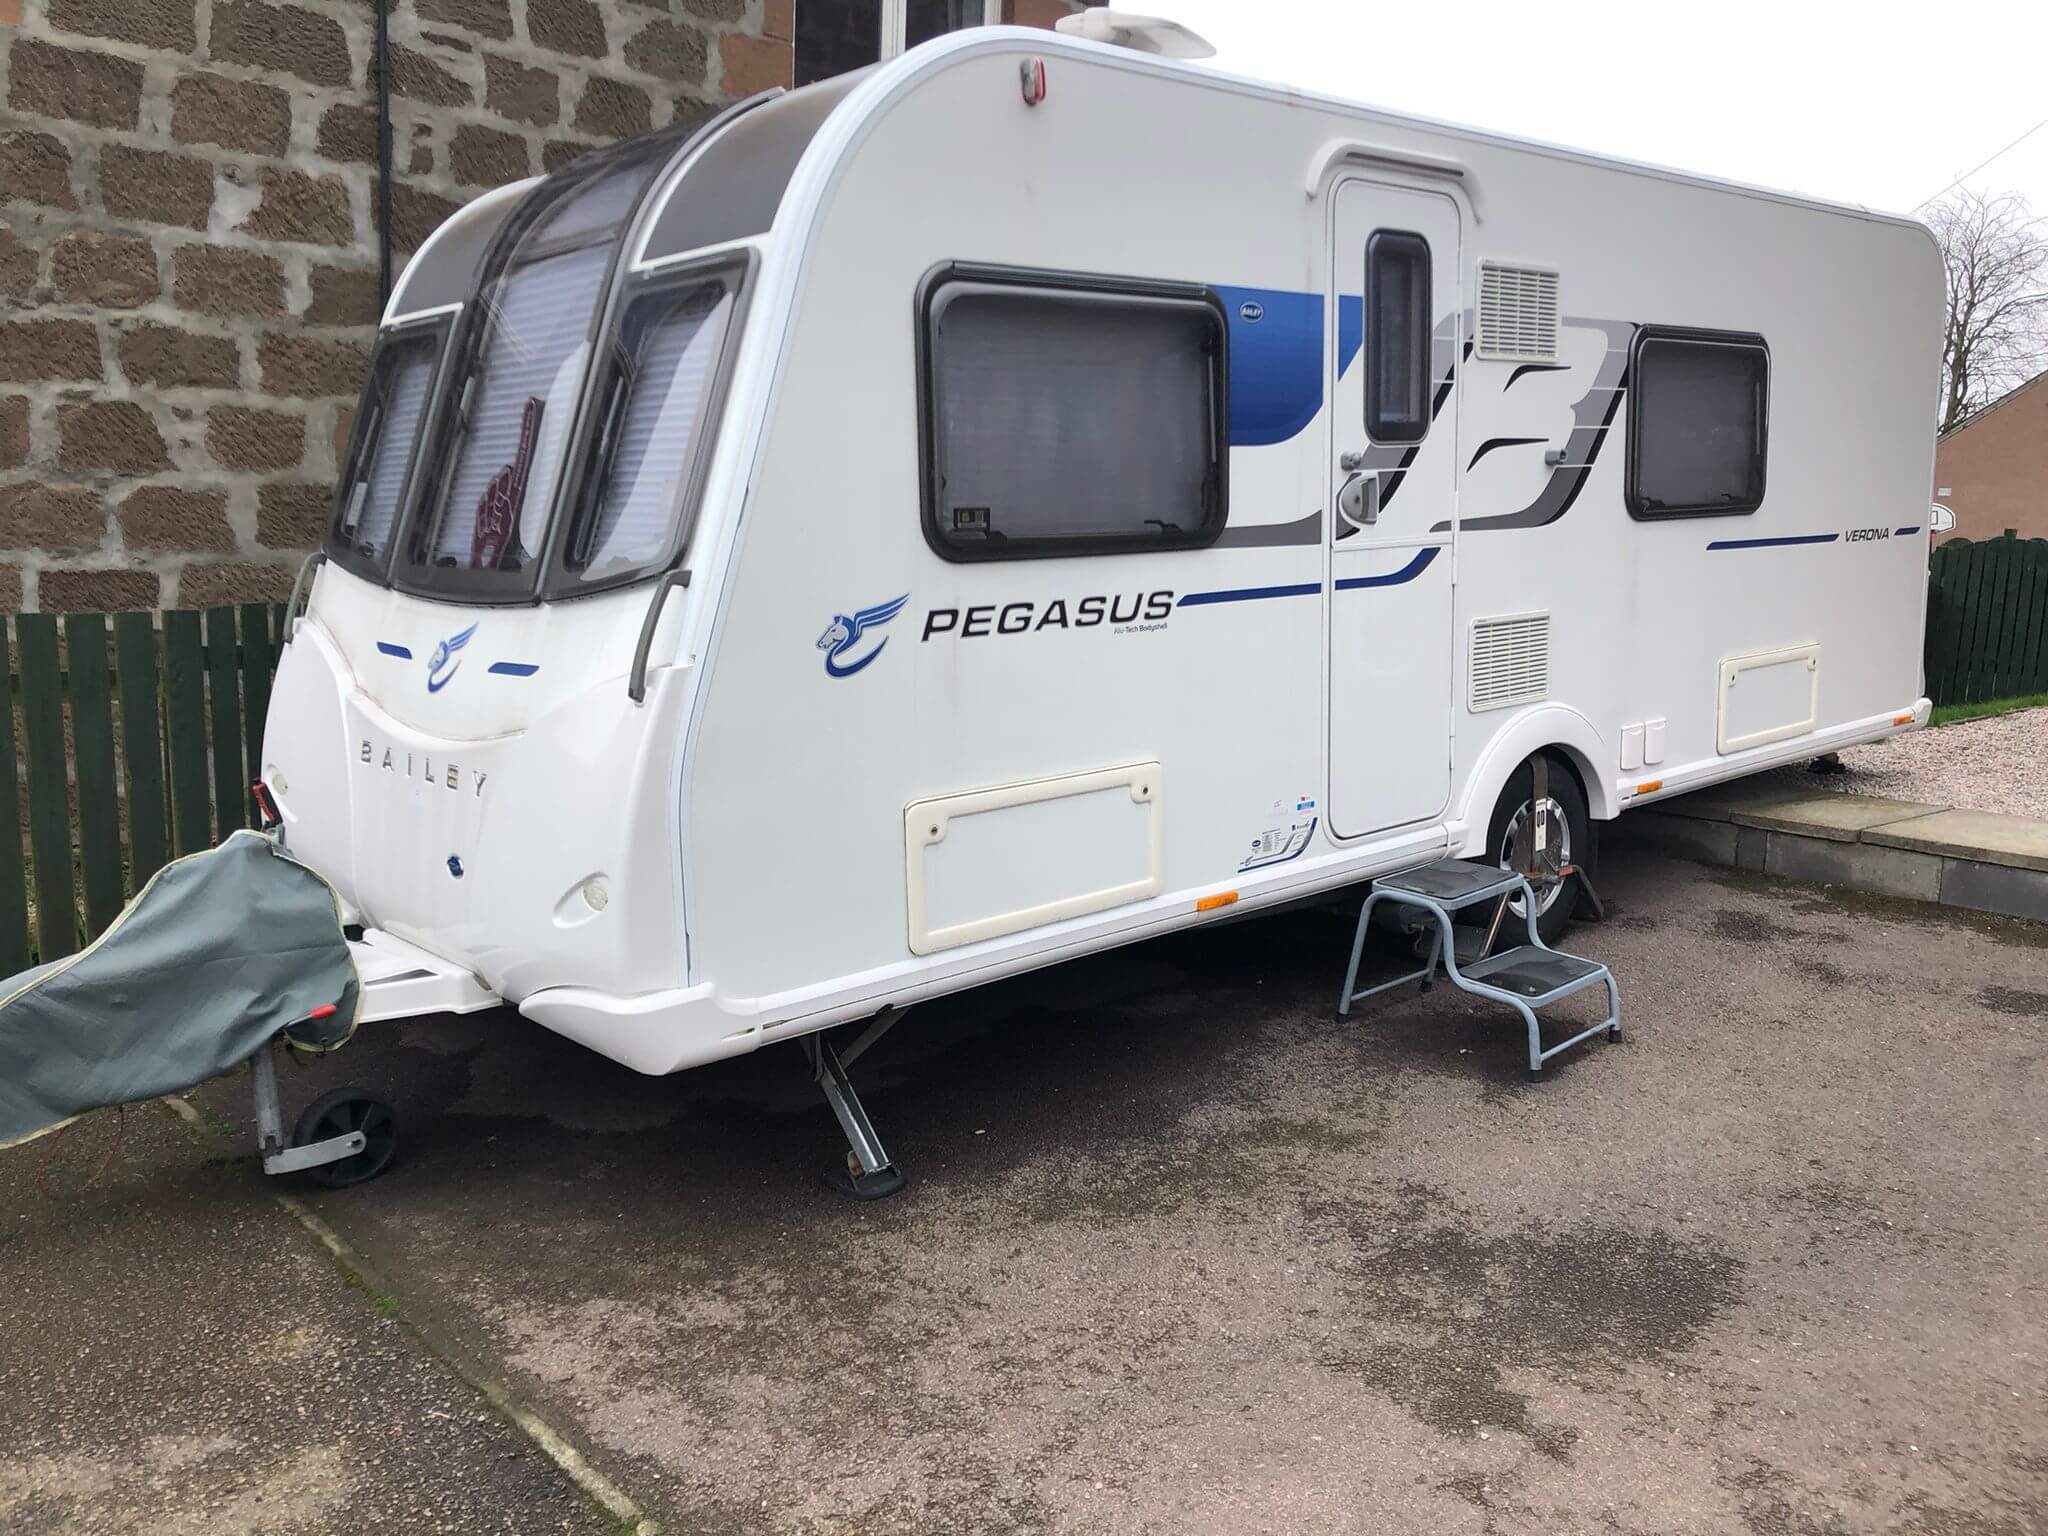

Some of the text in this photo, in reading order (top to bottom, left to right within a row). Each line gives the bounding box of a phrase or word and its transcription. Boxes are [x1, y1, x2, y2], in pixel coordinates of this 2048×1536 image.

[1845, 527, 1889, 542] VERONA
[921, 590, 1174, 642] PEGASUS
[1139, 622, 1168, 633] Bodyshell
[360, 740, 487, 798] BAILEY
